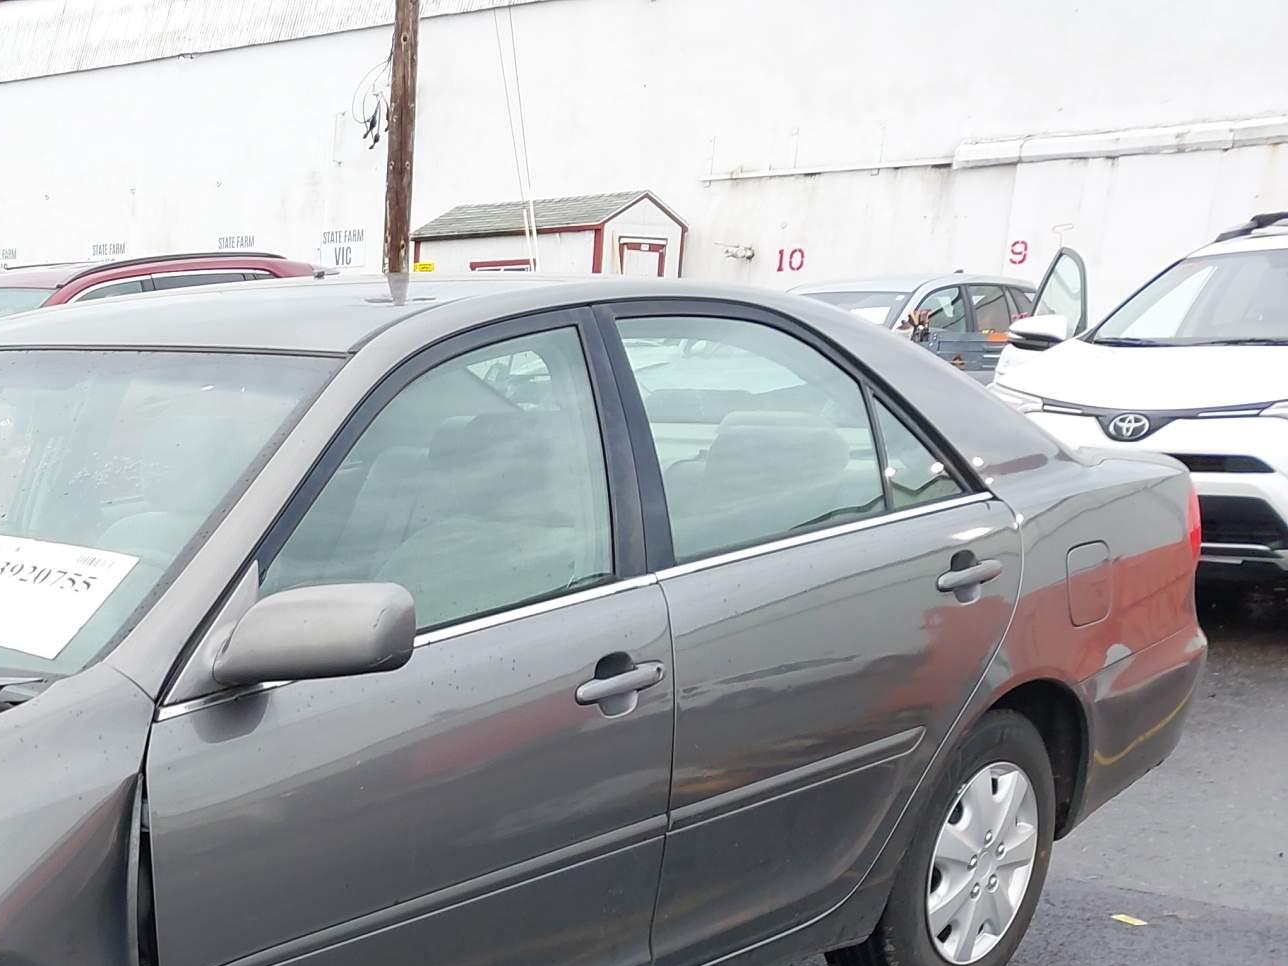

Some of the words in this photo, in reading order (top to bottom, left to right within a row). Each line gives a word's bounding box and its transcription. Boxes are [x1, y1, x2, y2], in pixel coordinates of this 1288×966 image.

[218, 236, 235, 249] STATE
[236, 235, 255, 248] FARM
[323, 231, 342, 244] STATE
[344, 229, 364, 242] FARM
[92, 244, 108, 256] STATE
[109, 242, 126, 255] FARM
[334, 247, 352, 266] VIC
[1009, 240, 1028, 264] 9
[777, 248, 805, 272] 10
